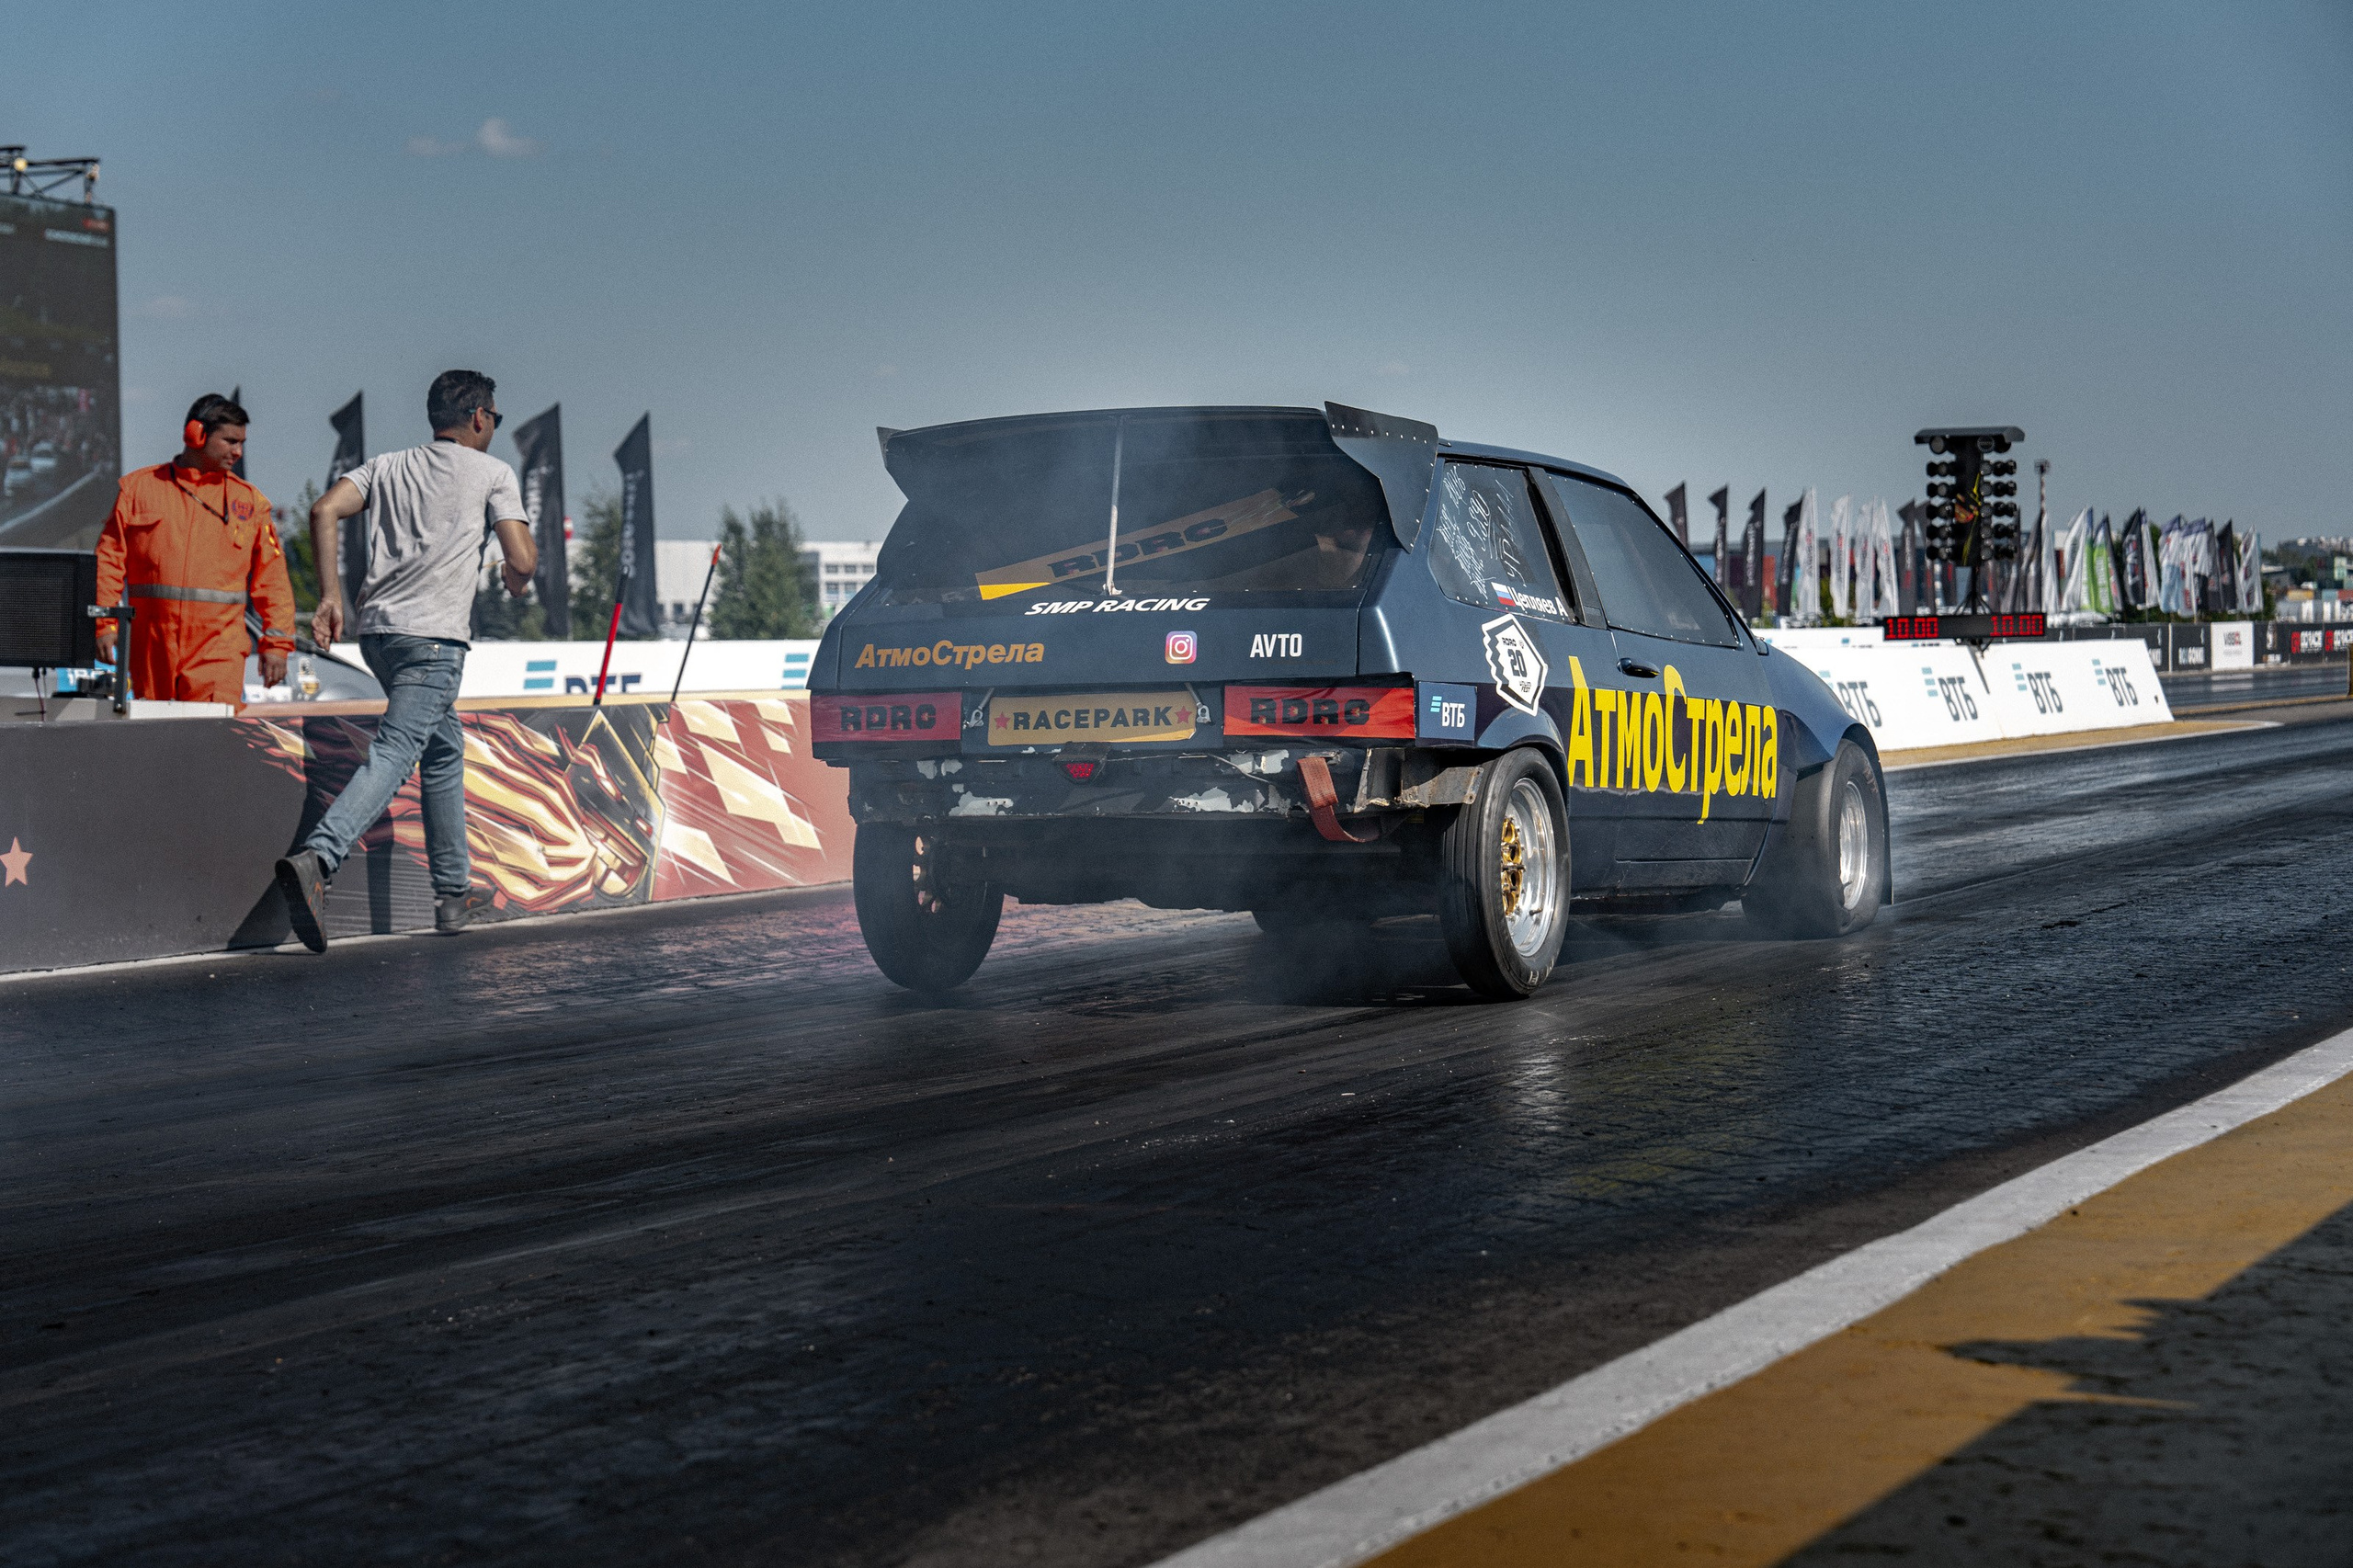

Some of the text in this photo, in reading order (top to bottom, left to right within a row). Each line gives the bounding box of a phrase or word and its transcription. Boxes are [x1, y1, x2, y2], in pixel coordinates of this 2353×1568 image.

[1047, 518, 1228, 578] RDRC
[1024, 598, 1211, 616] SMP RACING
[1507, 585, 1558, 615] Цепляев
[1885, 617, 1939, 640] 10.00
[1989, 614, 2043, 637] 10.00
[855, 640, 1045, 670] АтмоСтрела
[1250, 632, 1302, 658] AVTO
[1507, 648, 1528, 677] 20
[1938, 676, 1978, 722] ВТБ
[2027, 671, 2063, 714] ВТБ
[2105, 666, 2139, 707] ВТБ
[840, 703, 937, 732] RDRC
[1013, 705, 1173, 731] RACEPARK
[1249, 698, 1370, 726] RDRC
[1441, 701, 1466, 728] ВТБ
[1567, 655, 1778, 824] АтмоСтрела
